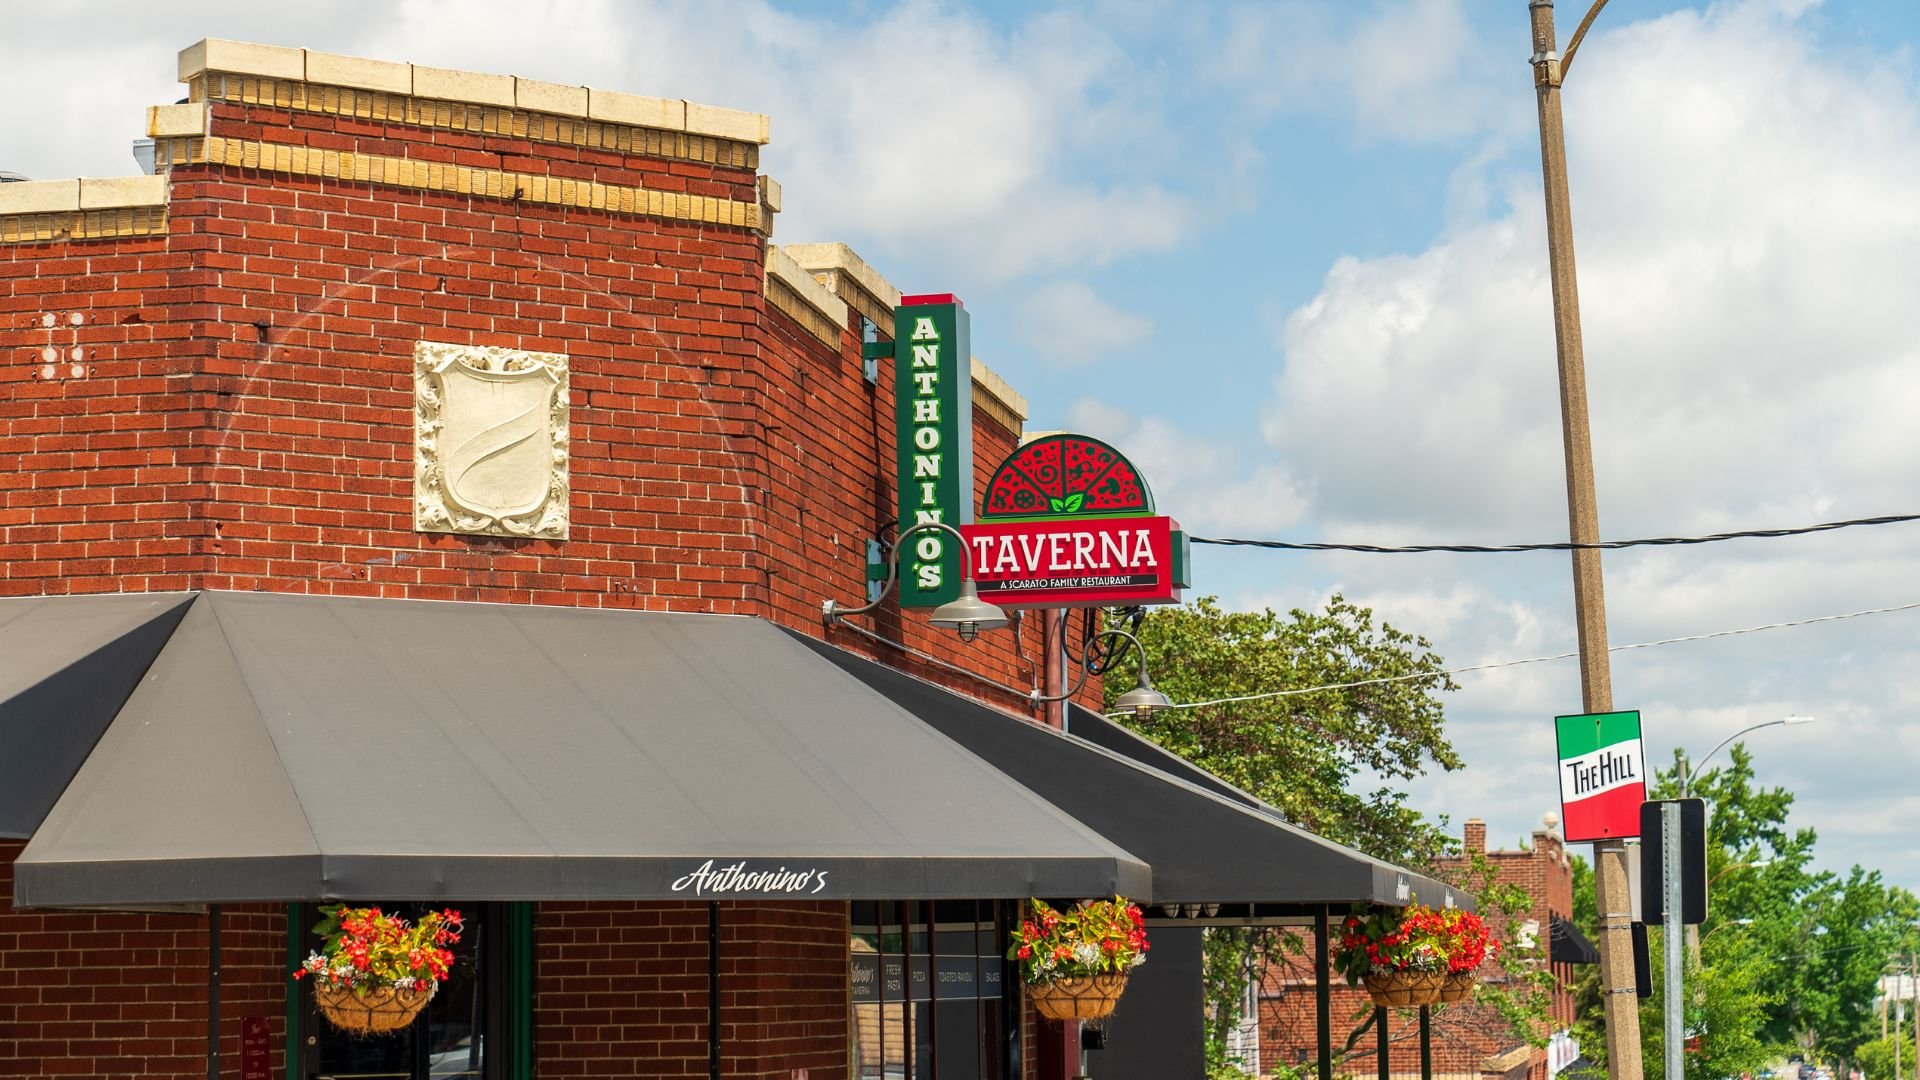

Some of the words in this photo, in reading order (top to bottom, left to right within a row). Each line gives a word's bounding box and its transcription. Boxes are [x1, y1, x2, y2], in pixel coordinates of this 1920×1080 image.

[912, 318, 942, 589] ANTHONINO'S
[973, 529, 1158, 574] TAVERNA
[1000, 580, 1007, 590] A
[1009, 579, 1048, 589] SCARATO
[1050, 577, 1080, 588] FAMILY
[1081, 575, 1132, 586] RESTAURANT
[671, 859, 829, 897] Anthonino's
